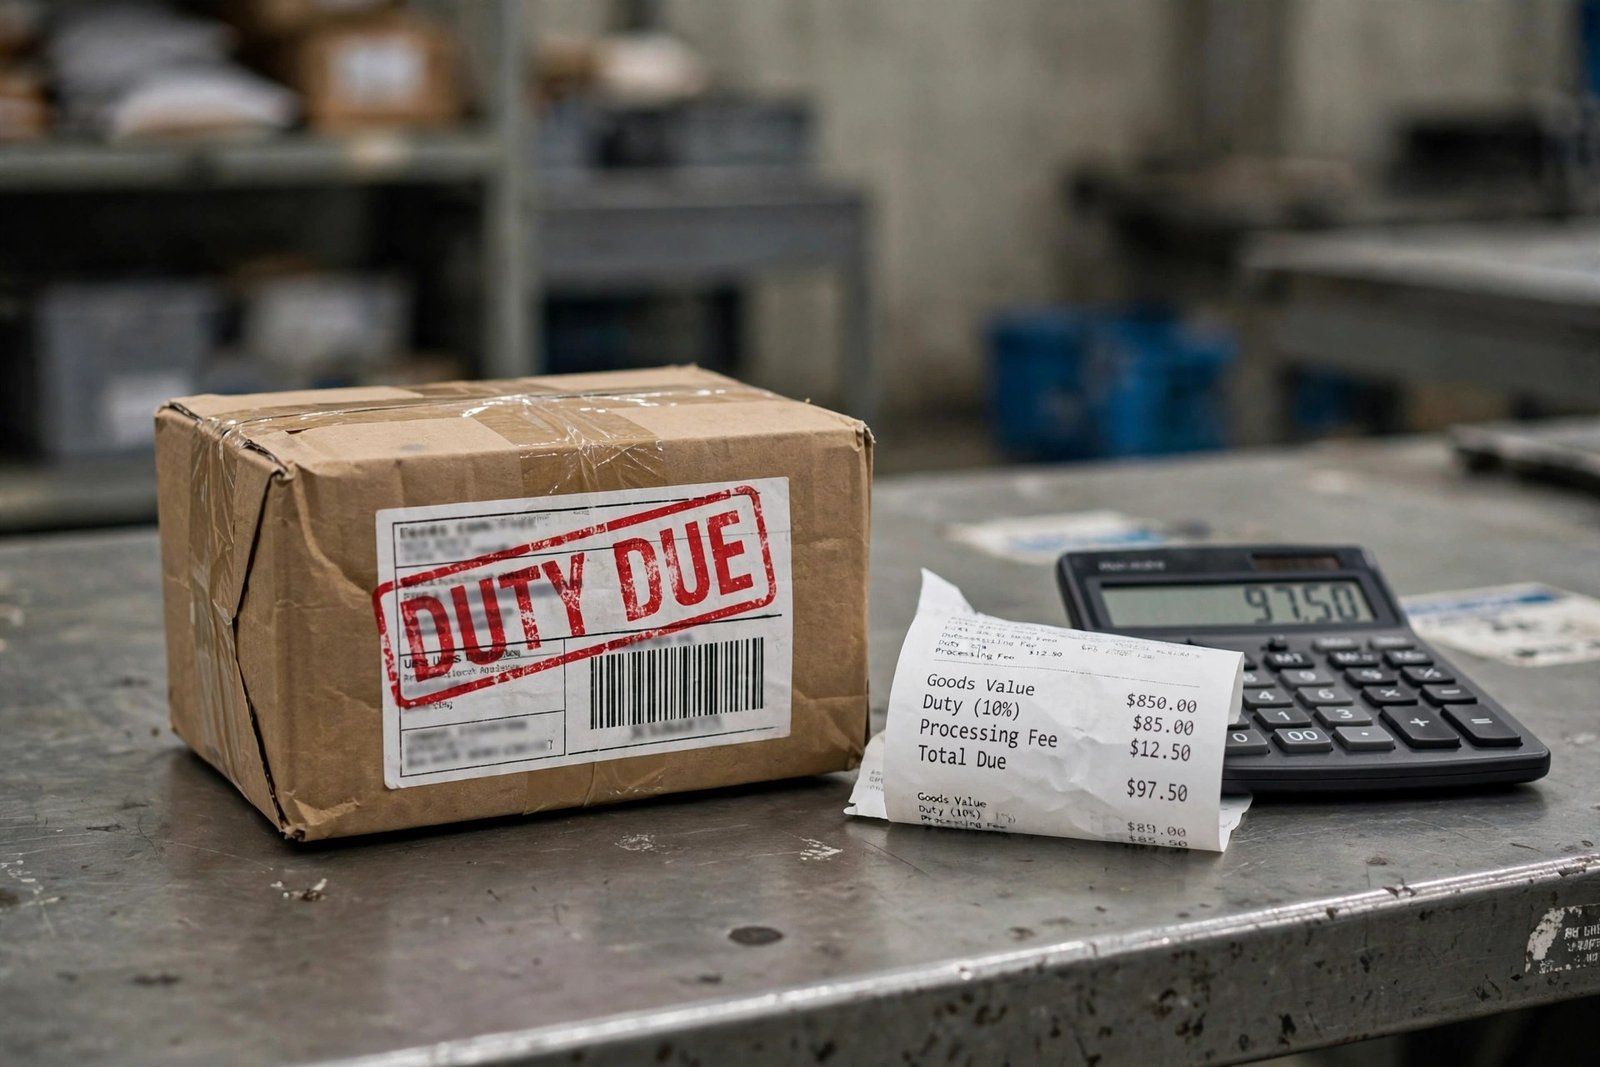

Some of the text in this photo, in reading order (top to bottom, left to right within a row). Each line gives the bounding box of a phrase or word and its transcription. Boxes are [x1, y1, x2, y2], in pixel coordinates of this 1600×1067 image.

[400, 510, 754, 682] DUTY DUE
[927, 673, 1035, 697] Goods Value
[1258, 690, 1275, 701] 4
[1318, 689, 1335, 699] 6
[923, 694, 1020, 720] Duty (10%)
[1126, 693, 1197, 714] $850.00
[1336, 709, 1353, 719] 3
[920, 718, 1058, 748] Processing Fee
[1133, 714, 1194, 736] $85.00
[1287, 730, 1318, 741] 00
[919, 744, 1007, 770] Total Due
[1130, 739, 1191, 762] $12.50
[917, 792, 987, 808] Goods Value
[1127, 777, 1188, 802] $97.50
[918, 804, 944, 817] Duty
[950, 808, 981, 820] (10%)
